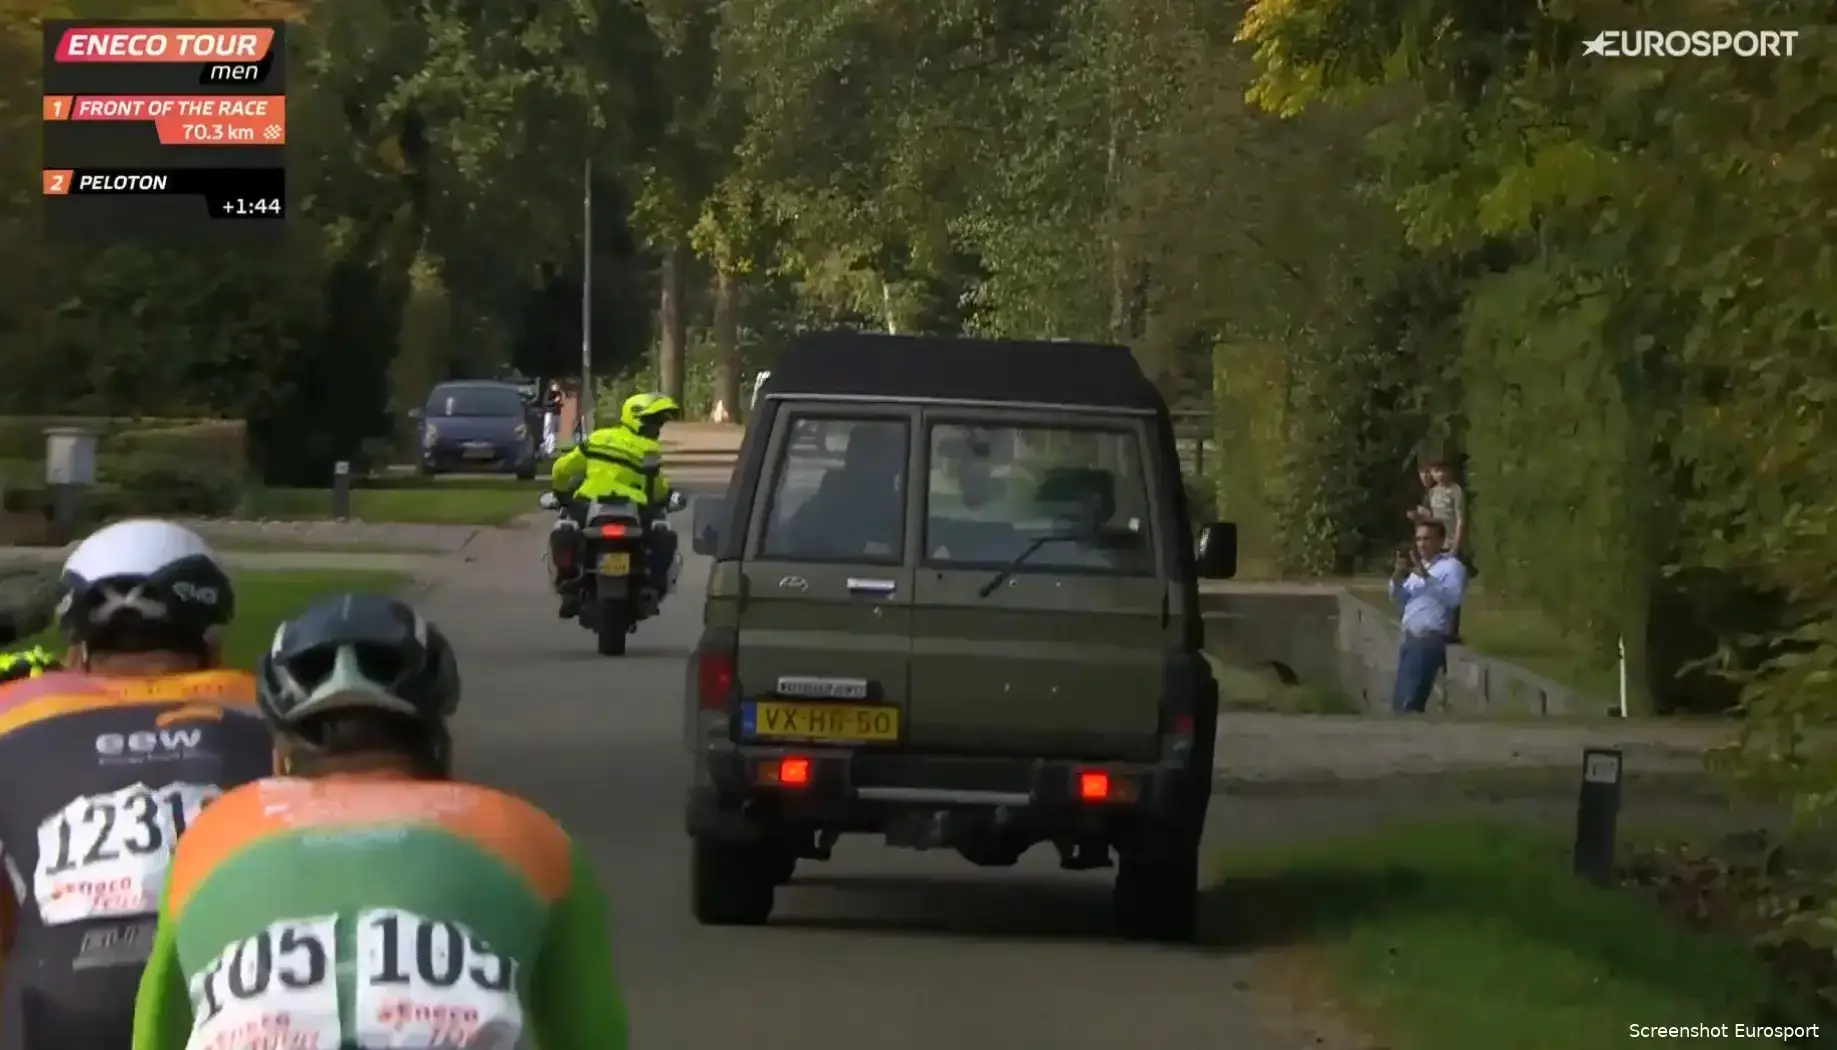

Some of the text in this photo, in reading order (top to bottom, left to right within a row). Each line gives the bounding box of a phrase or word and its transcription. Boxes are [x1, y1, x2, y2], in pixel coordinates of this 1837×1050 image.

[46, 792, 163, 875] 123
[200, 927, 326, 1027] 105
[368, 914, 513, 992] 105
